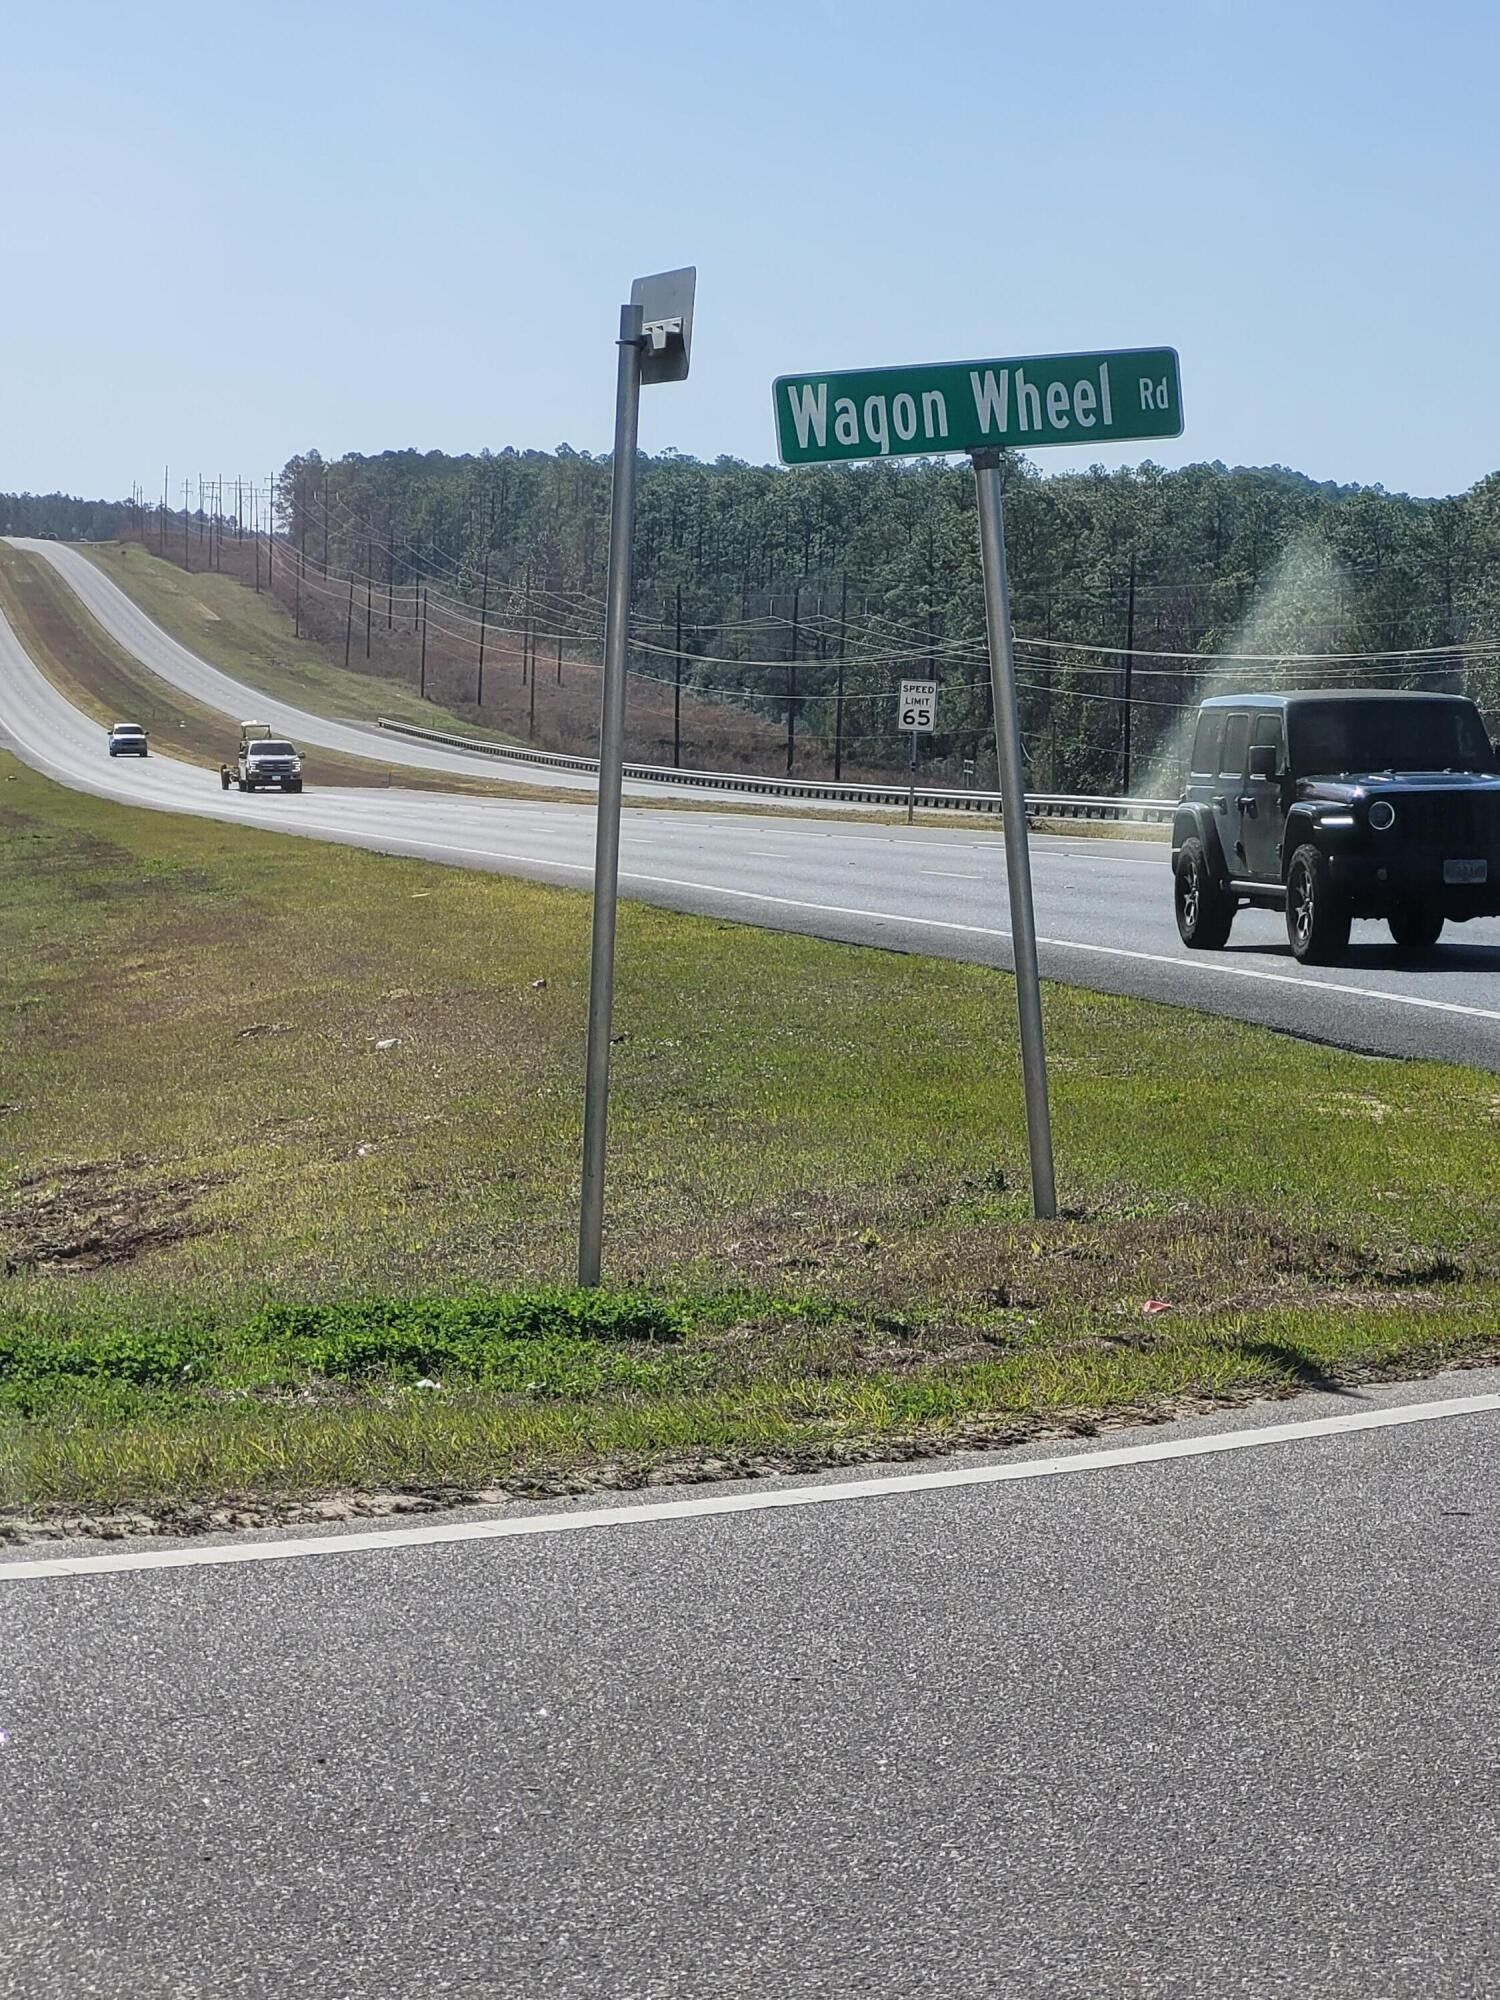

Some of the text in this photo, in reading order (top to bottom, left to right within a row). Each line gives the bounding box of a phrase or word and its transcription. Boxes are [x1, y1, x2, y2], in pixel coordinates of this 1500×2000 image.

[787, 362, 1169, 455] Wagon Wheel Rd
[903, 685, 935, 694] SPEED
[905, 697, 930, 706] LIMIT
[903, 709, 930, 726] 65
